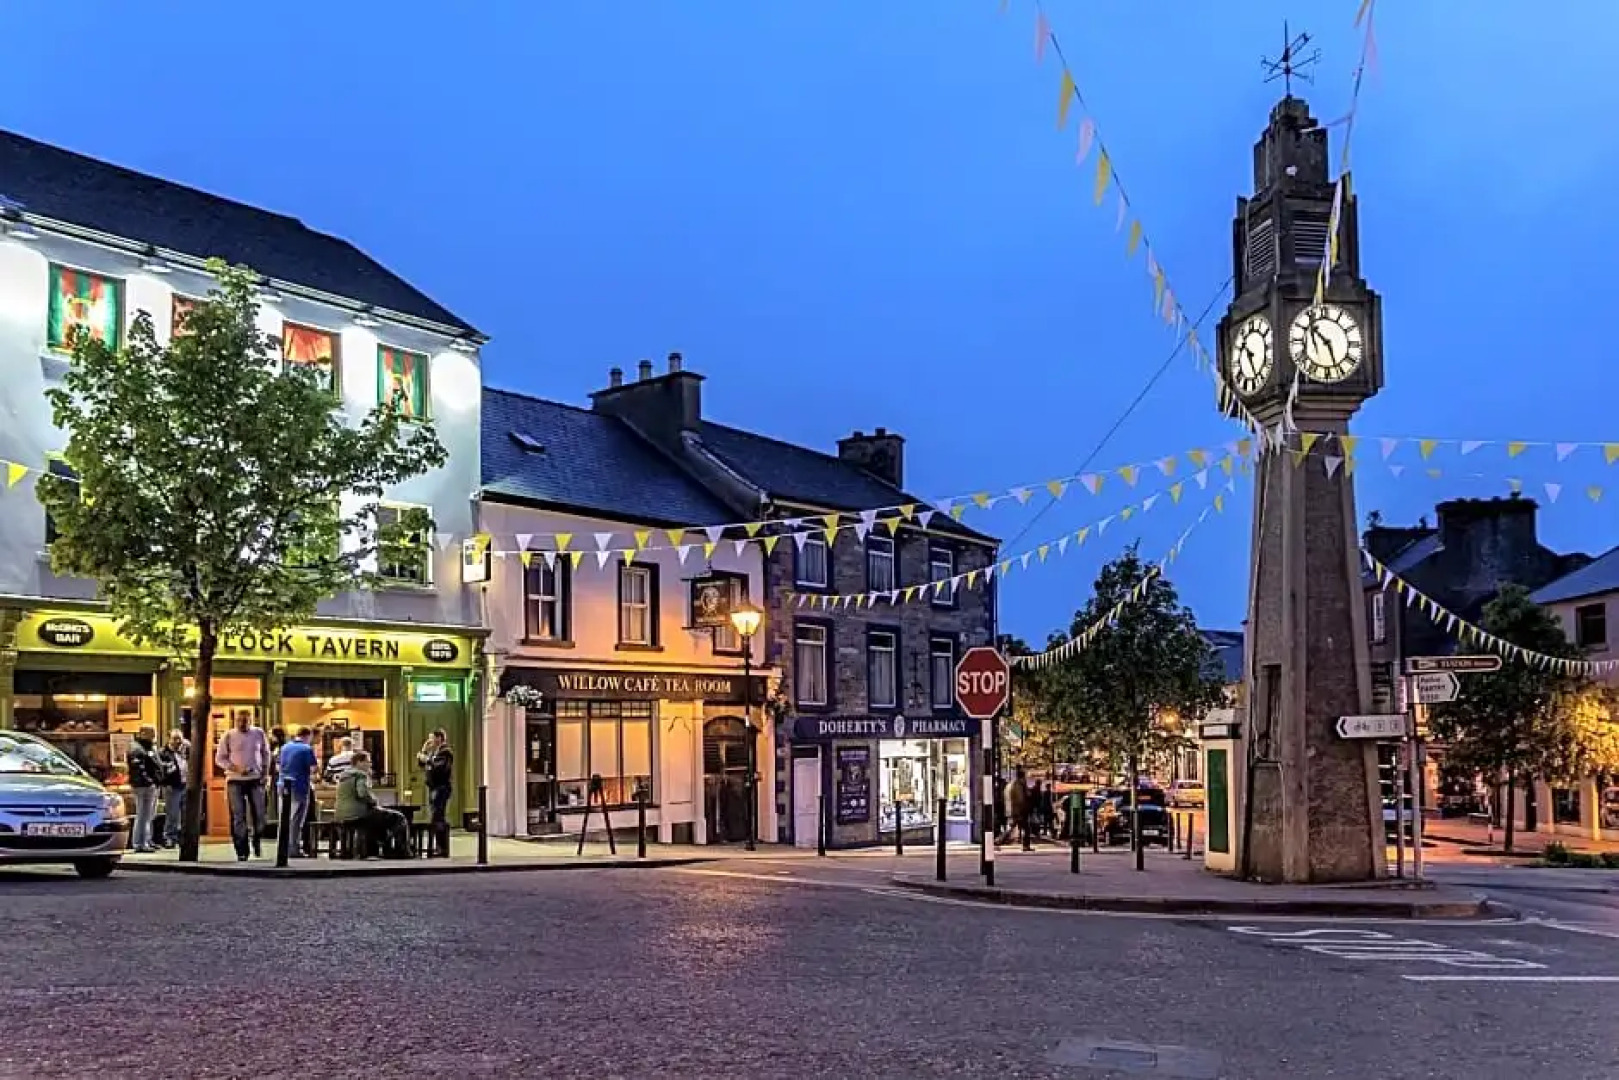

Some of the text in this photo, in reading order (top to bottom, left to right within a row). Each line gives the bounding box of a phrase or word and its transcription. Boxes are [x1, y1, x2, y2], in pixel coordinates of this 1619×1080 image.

[55, 633, 81, 644] BAR
[223, 627, 292, 652] LOCK
[307, 635, 399, 659] TAVERN
[558, 674, 732, 694] WILLOW CAFÉ TEA ROOM
[958, 671, 1005, 695] STOP
[819, 718, 967, 735] DOHERTY'S PHARMACY
